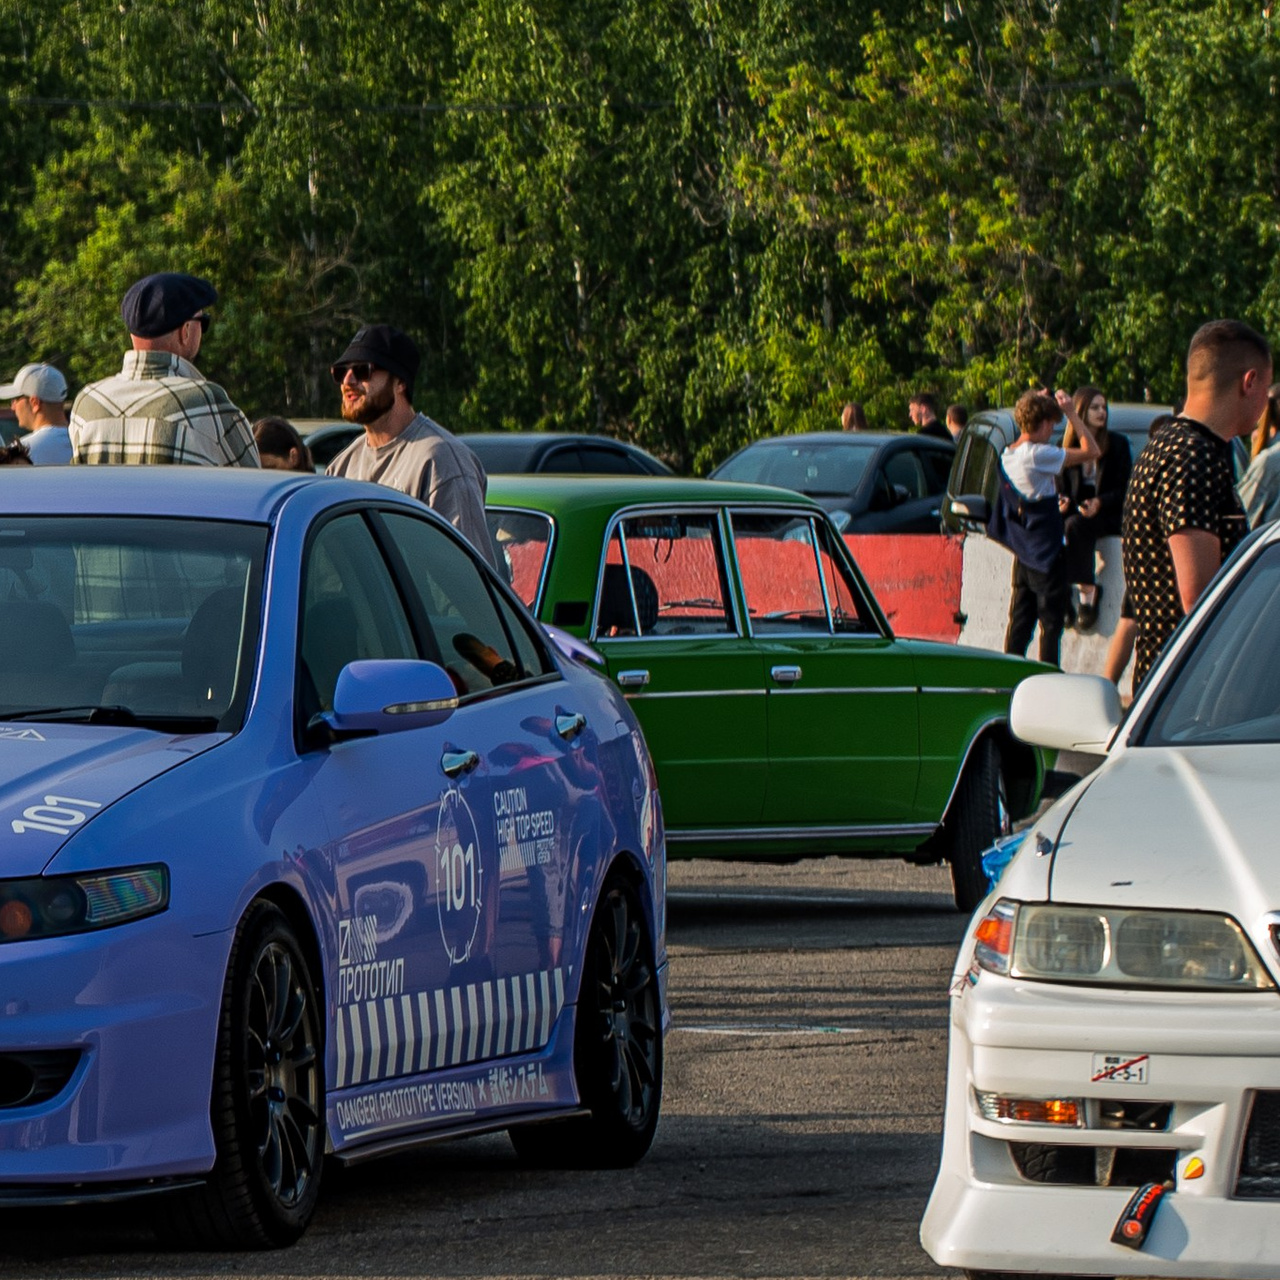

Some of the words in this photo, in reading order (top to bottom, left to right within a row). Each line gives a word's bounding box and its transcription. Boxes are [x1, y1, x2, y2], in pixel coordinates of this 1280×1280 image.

[11, 795, 102, 835] 101
[493, 786, 528, 817] CAUTION
[497, 815, 516, 844] HIGH
[515, 814, 531, 840] TOP
[531, 810, 555, 838] SPEED
[440, 843, 475, 912] 101
[337, 957, 404, 1006] ПРОТОТИП
[336, 1092, 379, 1131] DANGER!
[379, 1086, 436, 1121] PROTOTYPE
[434, 1081, 476, 1111] VERSION
